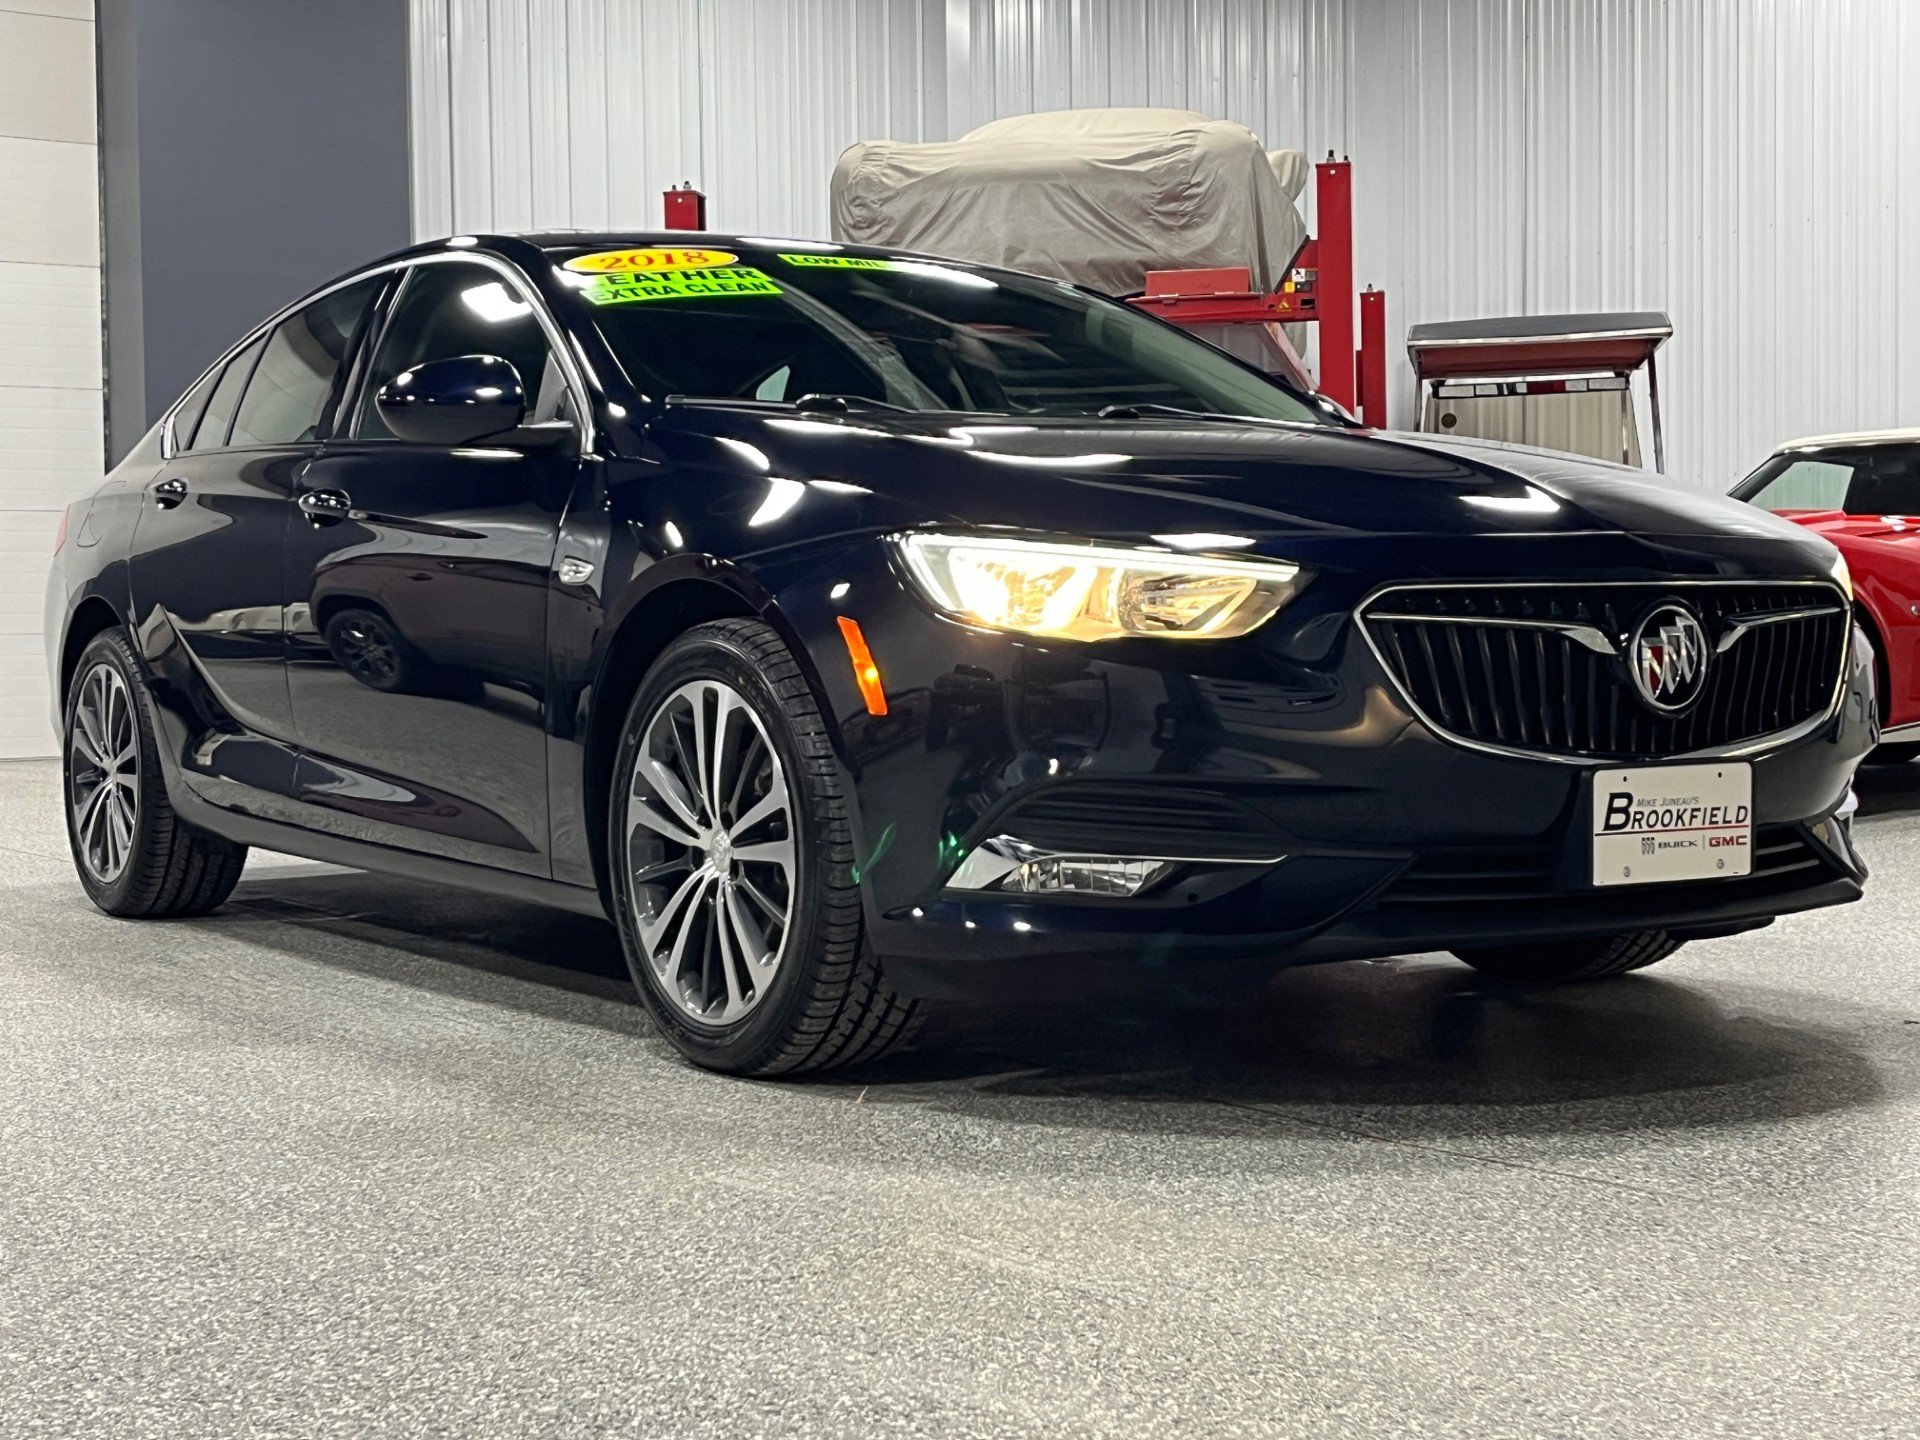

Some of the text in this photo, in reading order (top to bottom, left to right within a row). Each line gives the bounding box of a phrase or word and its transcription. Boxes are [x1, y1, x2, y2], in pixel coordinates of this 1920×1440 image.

[599, 252, 710, 269] 2018
[788, 256, 839, 265] LOW
[600, 270, 764, 286] EATHER
[685, 282, 770, 293] CLEAN
[1636, 797, 1699, 808] MIKE JUNEAU'S
[1602, 792, 1748, 831] BROOKFIELD
[1658, 835, 1748, 849] BUICK GMC
